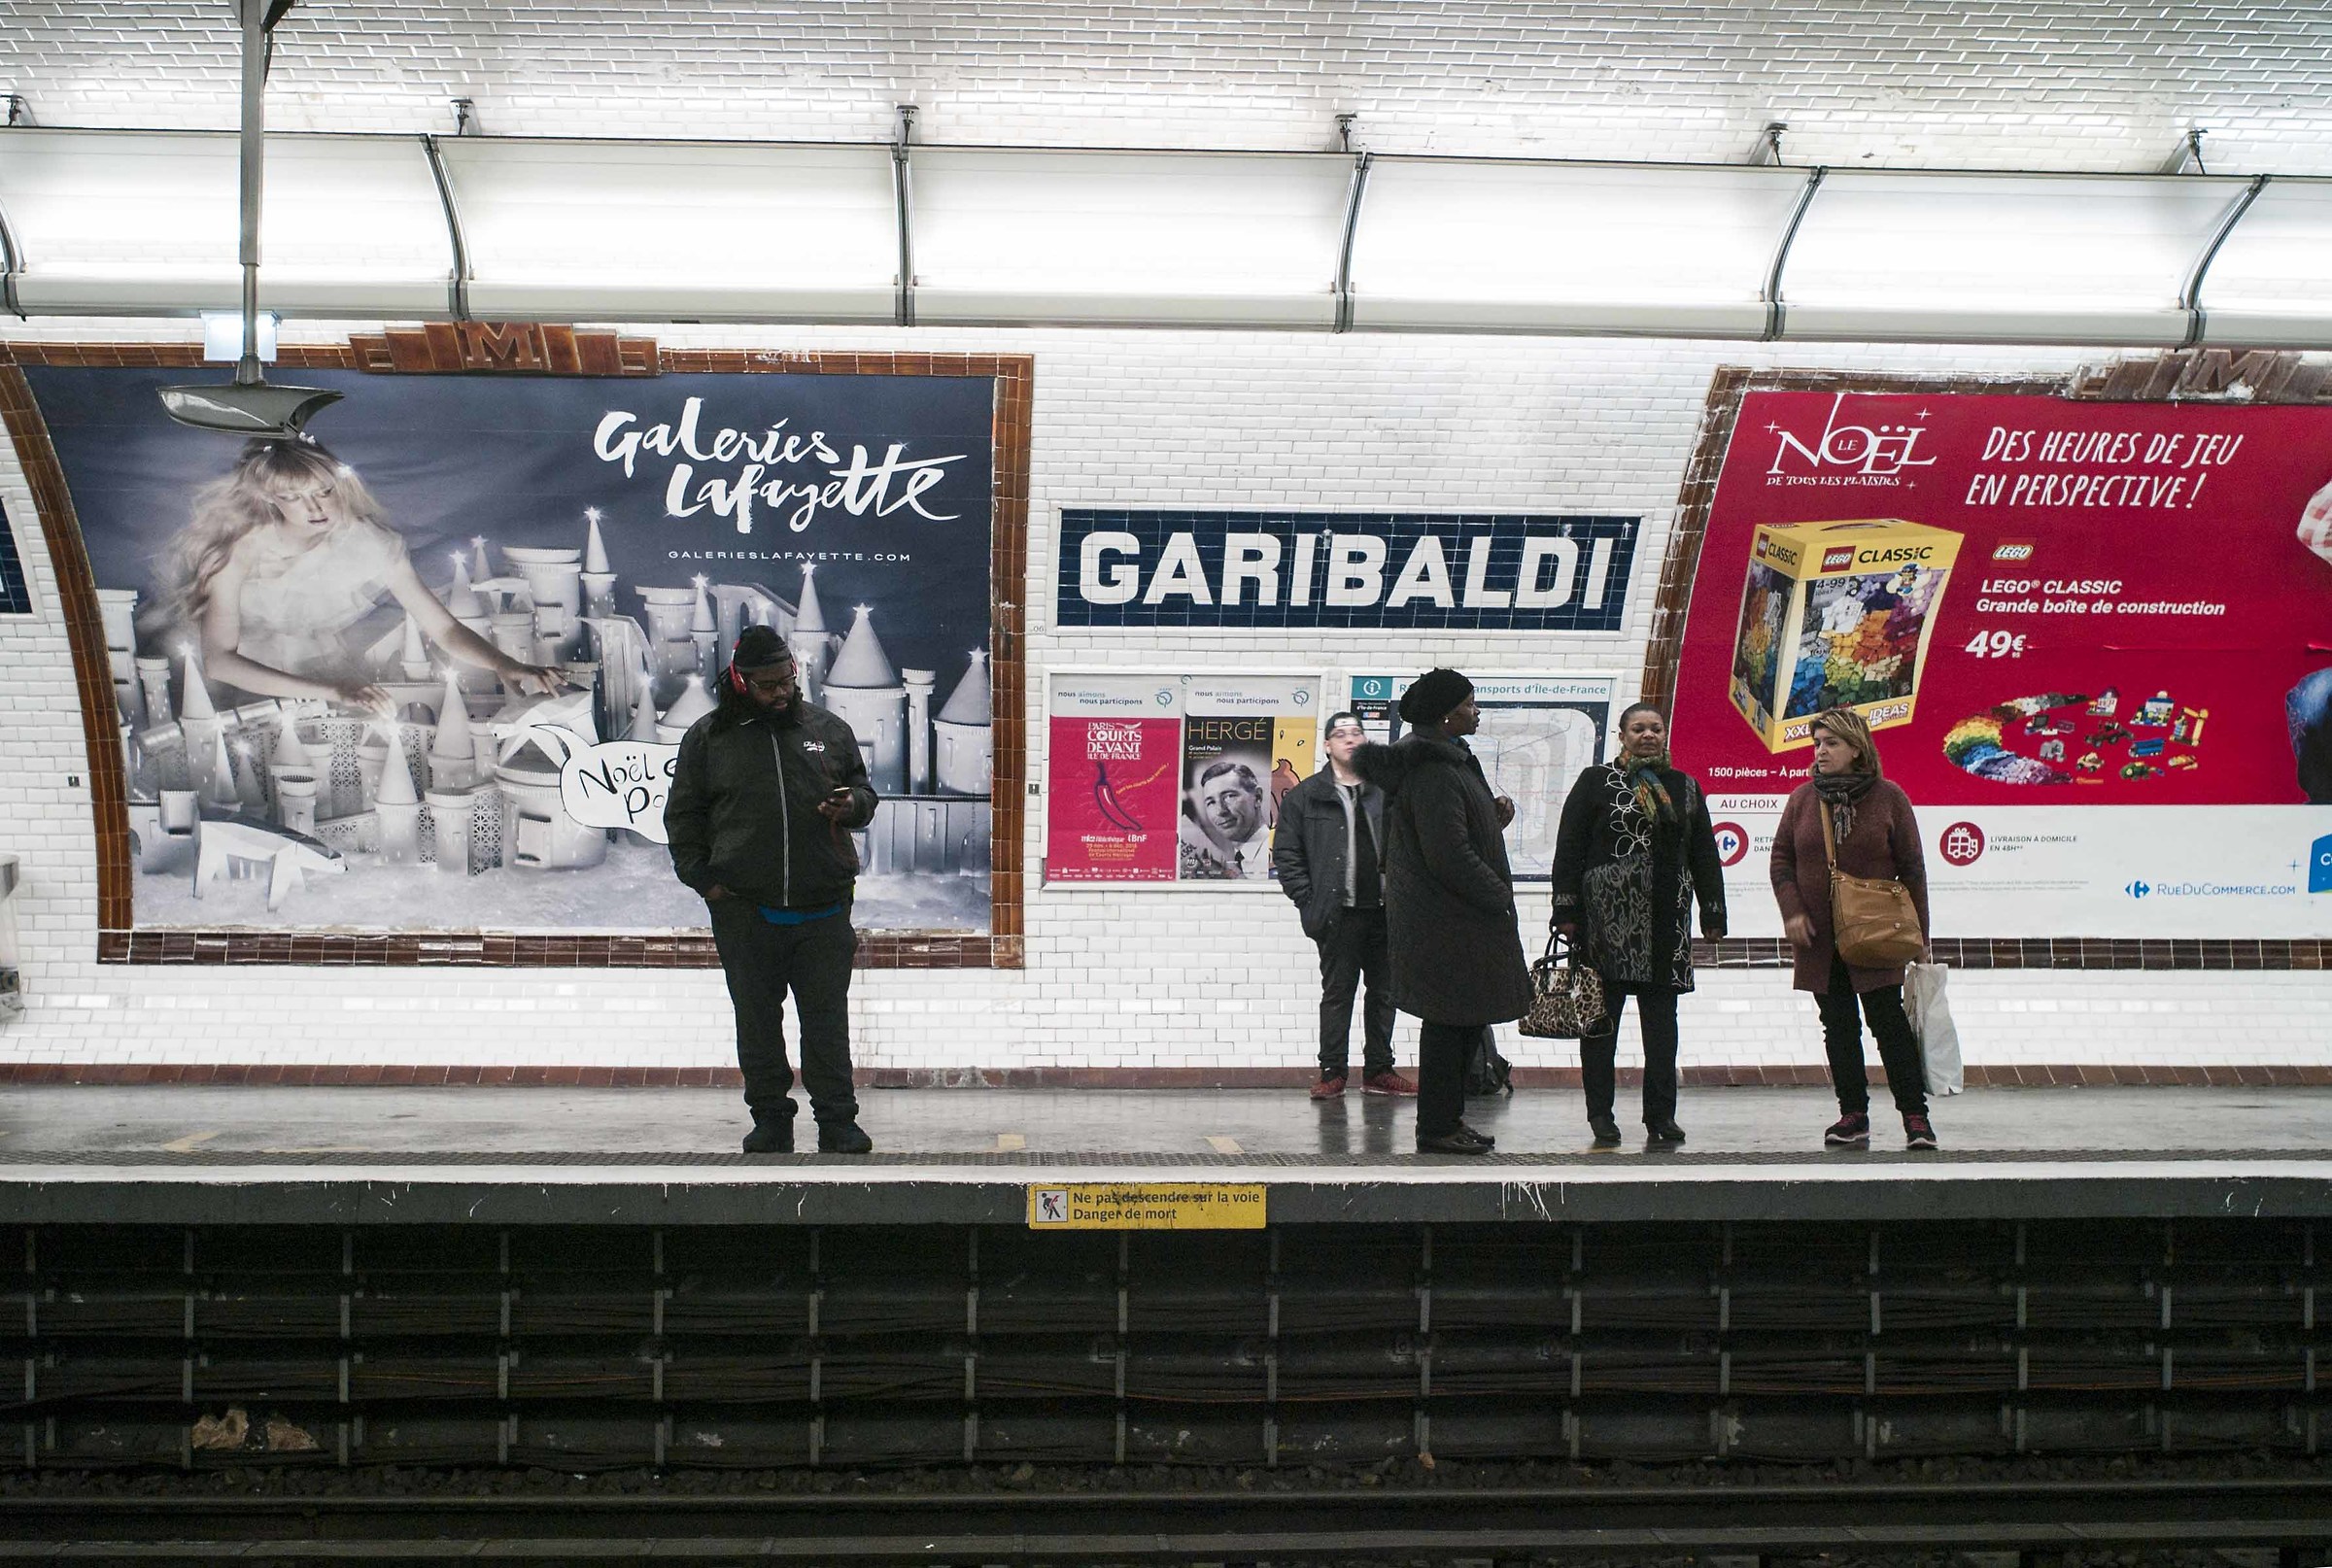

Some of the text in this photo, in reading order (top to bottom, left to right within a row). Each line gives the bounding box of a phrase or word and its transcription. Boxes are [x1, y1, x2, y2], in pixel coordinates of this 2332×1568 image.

[594, 396, 840, 478] Galeries
[1836, 439, 1858, 451] LE
[1981, 426, 2244, 469] DES HEURES DE JEU
[1766, 476, 1901, 487] DE TOUS LES PLAISIRS
[667, 444, 969, 533] Lafayette
[1965, 474, 2006, 505] EN
[2008, 473, 2187, 508] PERSPECTIVE
[668, 551, 911, 562] GALERIESLAFAYETTE.COM
[1824, 553, 1851, 565] LEGO
[1995, 545, 2033, 560] LEGO
[1079, 531, 1615, 610] GARIBALDI
[1816, 578, 1846, 590] 4-99
[2042, 580, 2122, 595] CLASSIC
[1975, 598, 2226, 615] Grande boîte de construction
[1078, 690, 1106, 699] aimons
[1194, 690, 1243, 699] nous aimons
[1473, 684, 1521, 696] ansports
[1099, 698, 1143, 706] participons
[1236, 698, 1280, 706] participons
[1869, 702, 1909, 721] IDEAS
[1087, 722, 1115, 731] PARIS
[1188, 717, 1267, 740] HERGÉ
[1087, 731, 1142, 742] COURTS
[1087, 741, 1142, 753] DEVANT
[579, 752, 656, 800] Noël
[1708, 767, 1733, 777] 1500
[1734, 767, 1767, 779] pièces
[1779, 765, 1788, 777] À
[1789, 767, 1809, 779] part
[1720, 799, 1778, 808] AU CHOIX
[1073, 1191, 1260, 1207] Ne pas descendre sur la voie
[1073, 1208, 1178, 1222] Danger de mort
